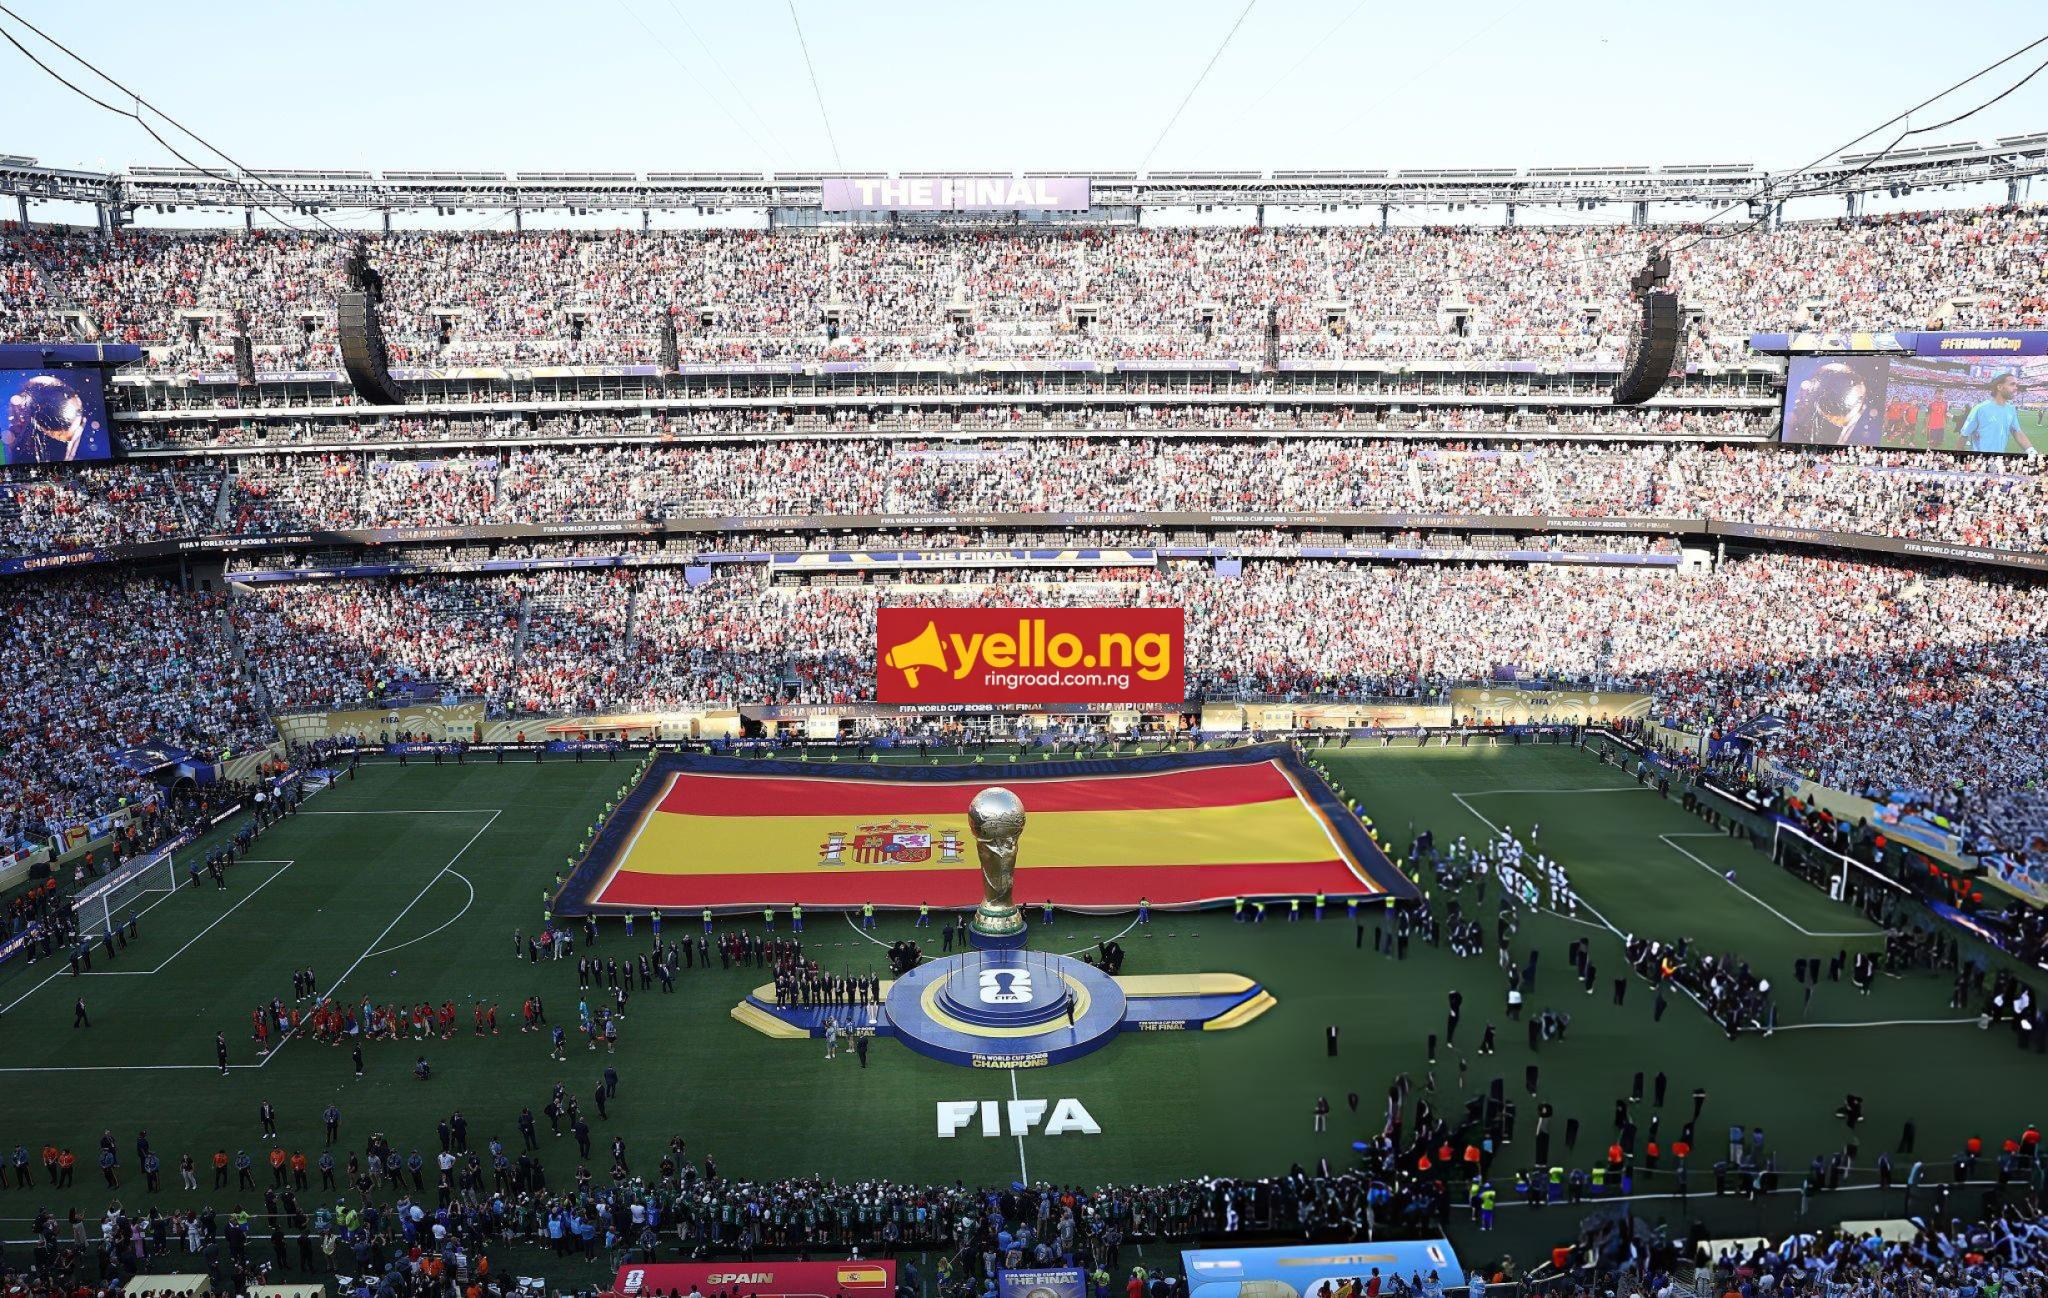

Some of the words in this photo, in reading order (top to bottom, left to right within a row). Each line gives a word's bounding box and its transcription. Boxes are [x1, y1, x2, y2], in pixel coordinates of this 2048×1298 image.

[854, 179, 933, 206] THE
[940, 178, 1058, 206] FINAL
[1940, 336, 2022, 351] #FIFAWorldCup
[397, 529, 464, 539] CHAMPIONS
[918, 552, 956, 560] THE
[960, 552, 1017, 560] FINAL
[1904, 544, 1921, 552] FIFA
[1922, 545, 1950, 554] WORLD
[1966, 549, 1994, 559] 2026
[24, 552, 95, 570] CHAMPIONS
[780, 706, 856, 716] CHAMPIONS
[1088, 702, 1162, 711] CHAMPIONS
[972, 1058, 1048, 1068] CHAMPIONS
[937, 1098, 1101, 1137] FIFA
[707, 1273, 773, 1285] SPAIN
[1037, 1276, 1078, 1284] FINAL
